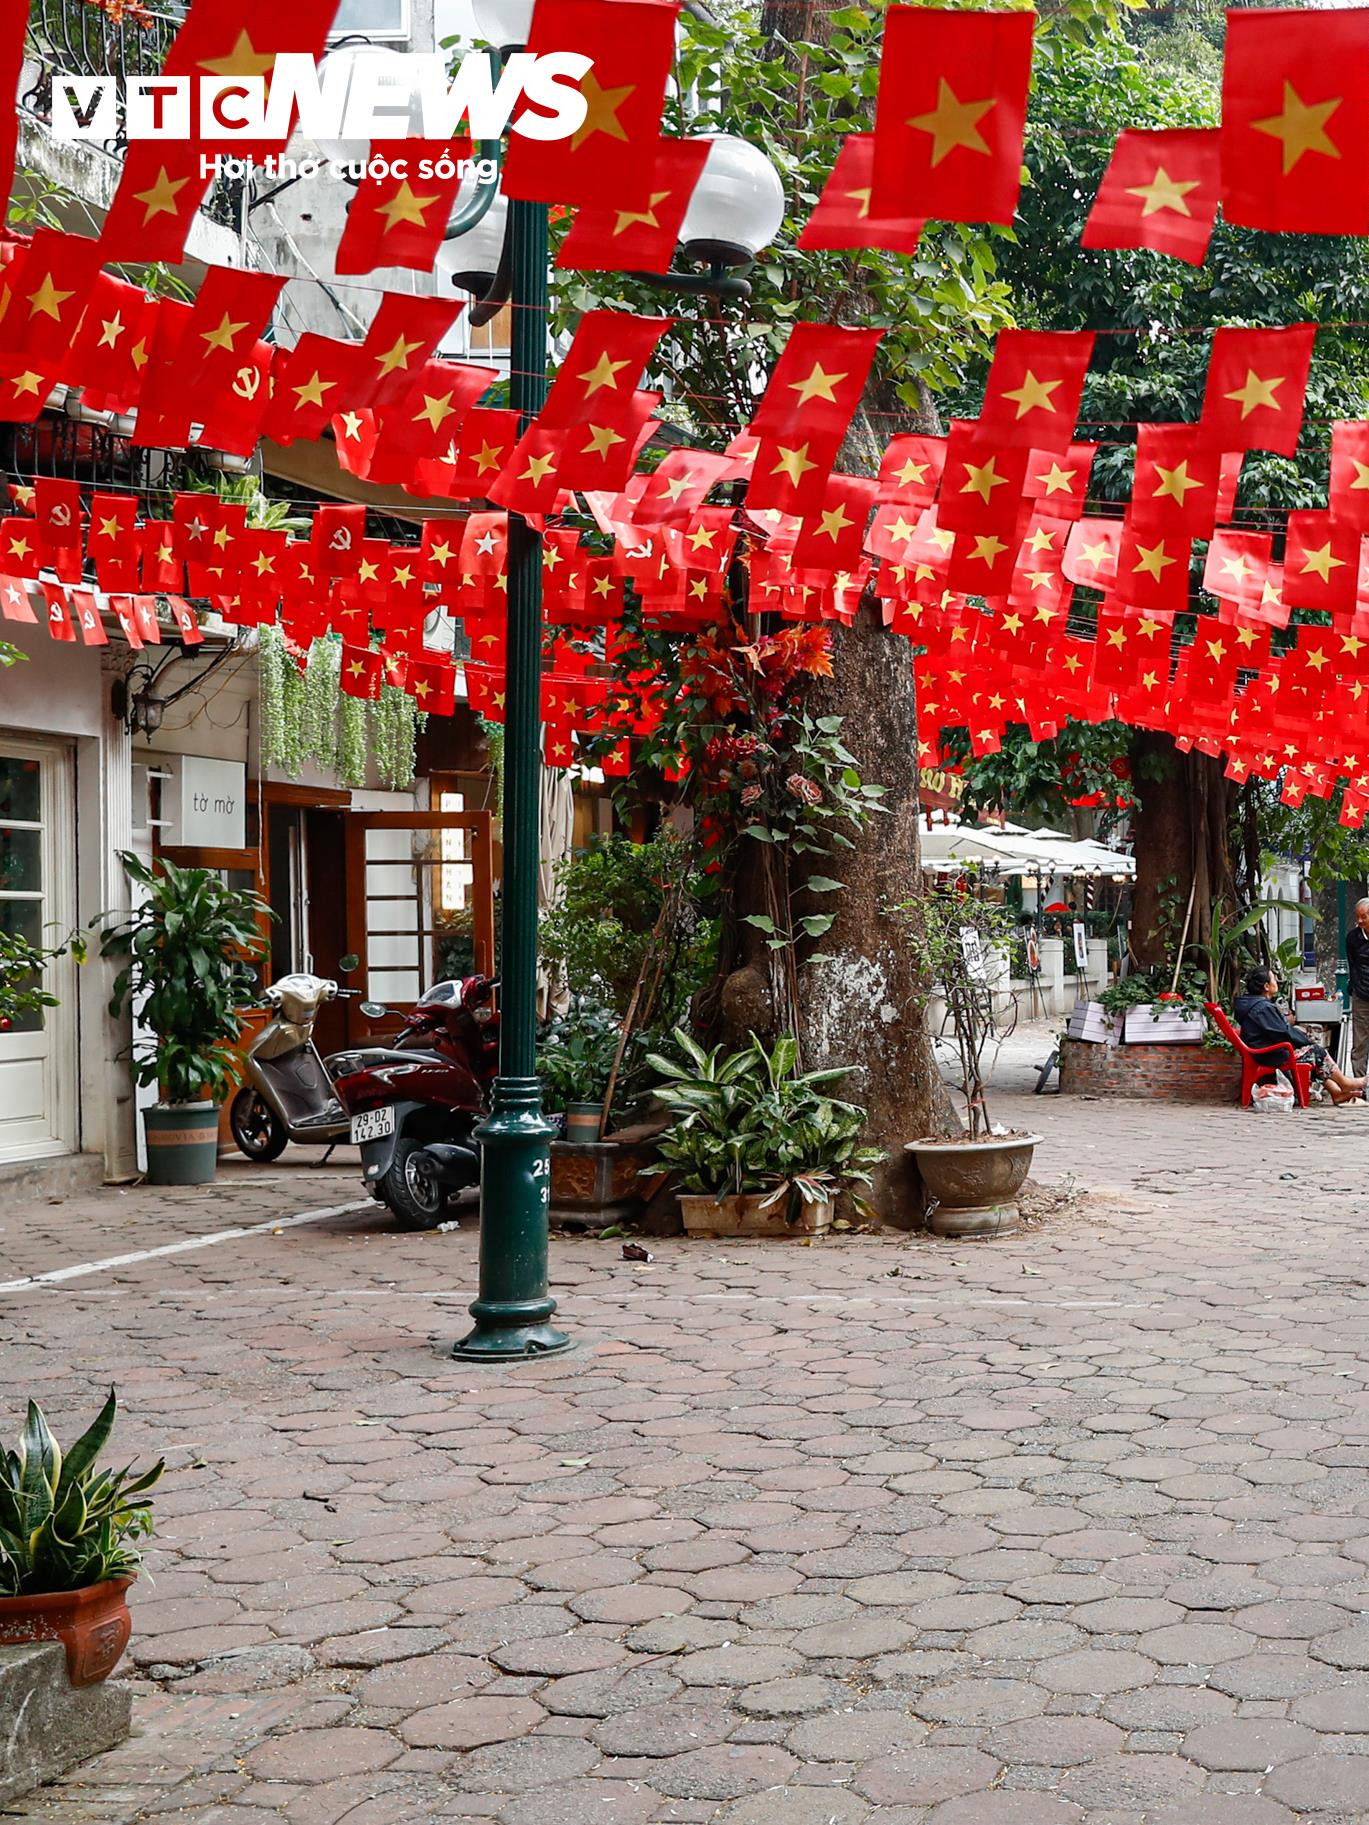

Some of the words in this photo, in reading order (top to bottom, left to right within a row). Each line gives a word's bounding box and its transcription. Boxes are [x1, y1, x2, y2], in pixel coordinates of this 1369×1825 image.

[193, 792, 208, 812] tờ
[214, 794, 235, 814] mờ
[355, 1121, 391, 1142] 142.30
